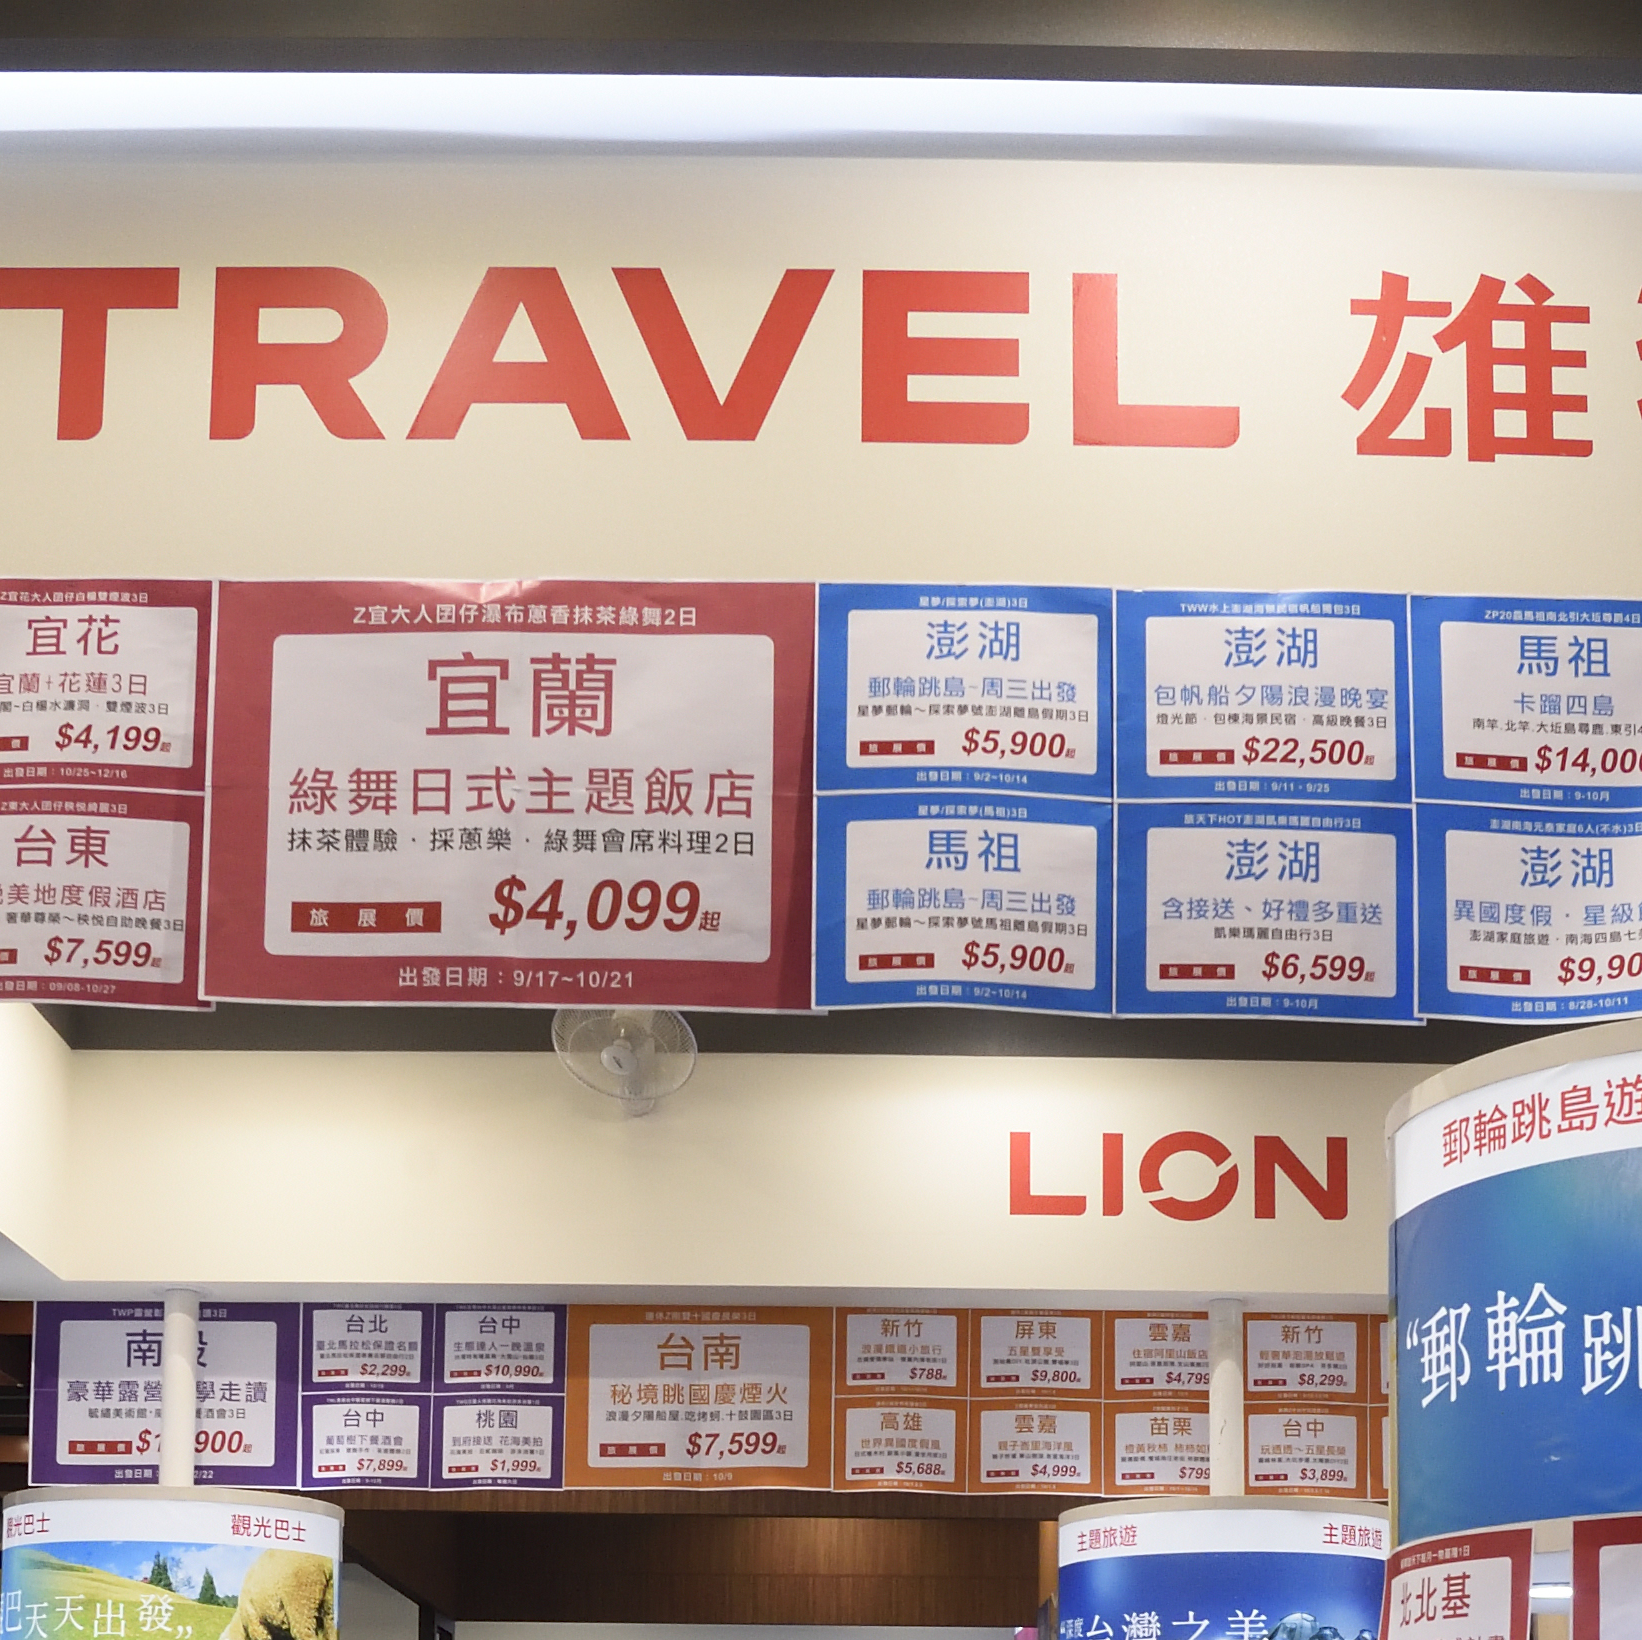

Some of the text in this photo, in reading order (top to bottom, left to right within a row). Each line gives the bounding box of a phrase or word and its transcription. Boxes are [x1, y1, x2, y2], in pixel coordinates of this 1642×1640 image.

[26, 615, 120, 655] 宜花
[926, 620, 1020, 661] 澎湖
[1225, 626, 1317, 668] 澎湖
[1517, 636, 1610, 677] 馬祖
[426, 652, 616, 737] 宜蘭
[1155, 684, 1388, 710] 包帆船夕陽浪漫晚宴
[1514, 692, 1614, 717] 卡蹓四島
[289, 766, 754, 818] 綠舞日式主題飯店
[15, 825, 110, 868] 台東
[926, 830, 1021, 872] 馬祖
[1226, 839, 1319, 883] 澎湖
[1521, 846, 1613, 888] 澎湖
[1010, 1131, 1349, 1221] LION
[346, 1314, 388, 1333] 台北
[479, 1315, 520, 1334] 台中
[881, 1318, 923, 1337] 新竹
[1015, 1321, 1056, 1339] 屏東
[1281, 1325, 1323, 1344] 新竹
[657, 1332, 741, 1371] 台南
[611, 1383, 787, 1405] 秘境眺國慶煙火
[343, 1409, 384, 1427] 台中
[476, 1410, 518, 1429] 桃園
[1283, 1419, 1324, 1438] 台中
[231, 1514, 306, 1542] 觀光巴士
[1077, 1525, 1137, 1552] 主題旅遊
[1323, 1523, 1382, 1550] 主題旅遊
[1400, 1572, 1471, 1627] 北北基
